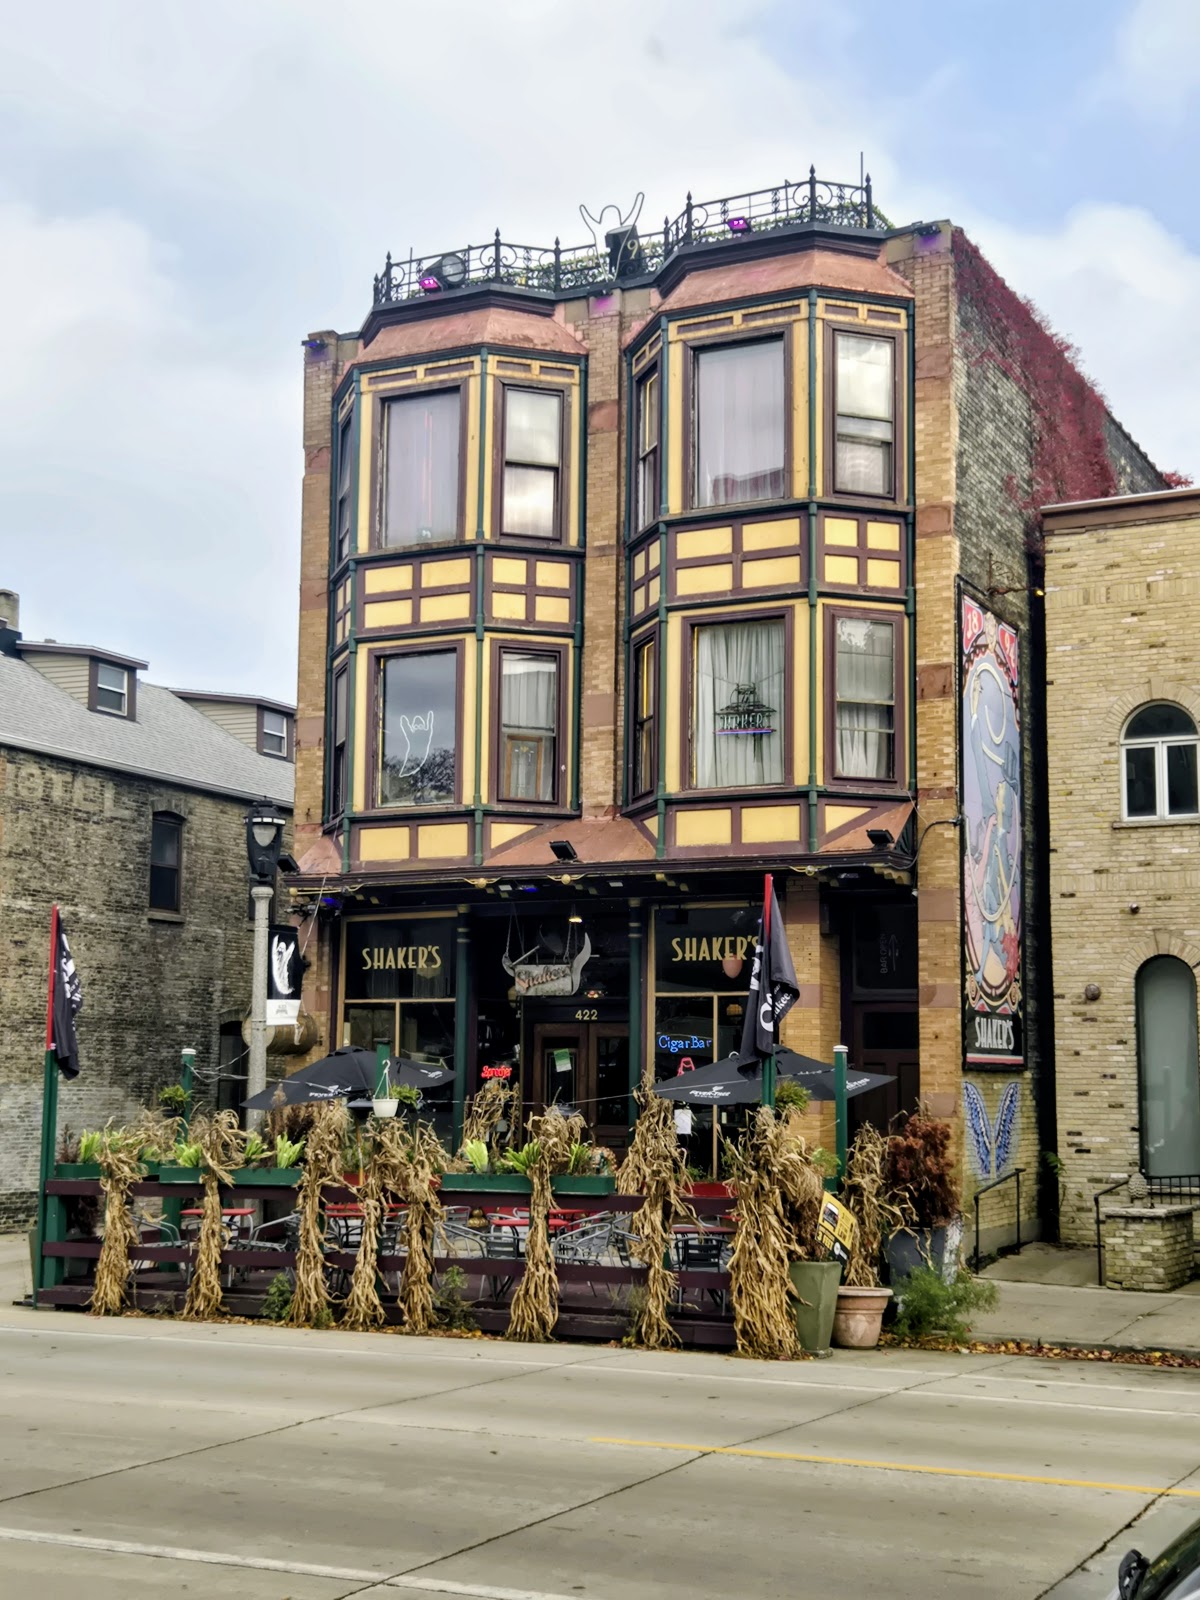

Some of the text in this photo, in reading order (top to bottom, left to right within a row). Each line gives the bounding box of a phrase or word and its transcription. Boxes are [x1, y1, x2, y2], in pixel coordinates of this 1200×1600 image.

[966, 610, 979, 639] 18
[361, 945, 442, 970] SHAKER'S
[575, 1009, 598, 1021] 422
[658, 1035, 712, 1053] Cigar Bar
[975, 1017, 1014, 1050] SHAKER'S
